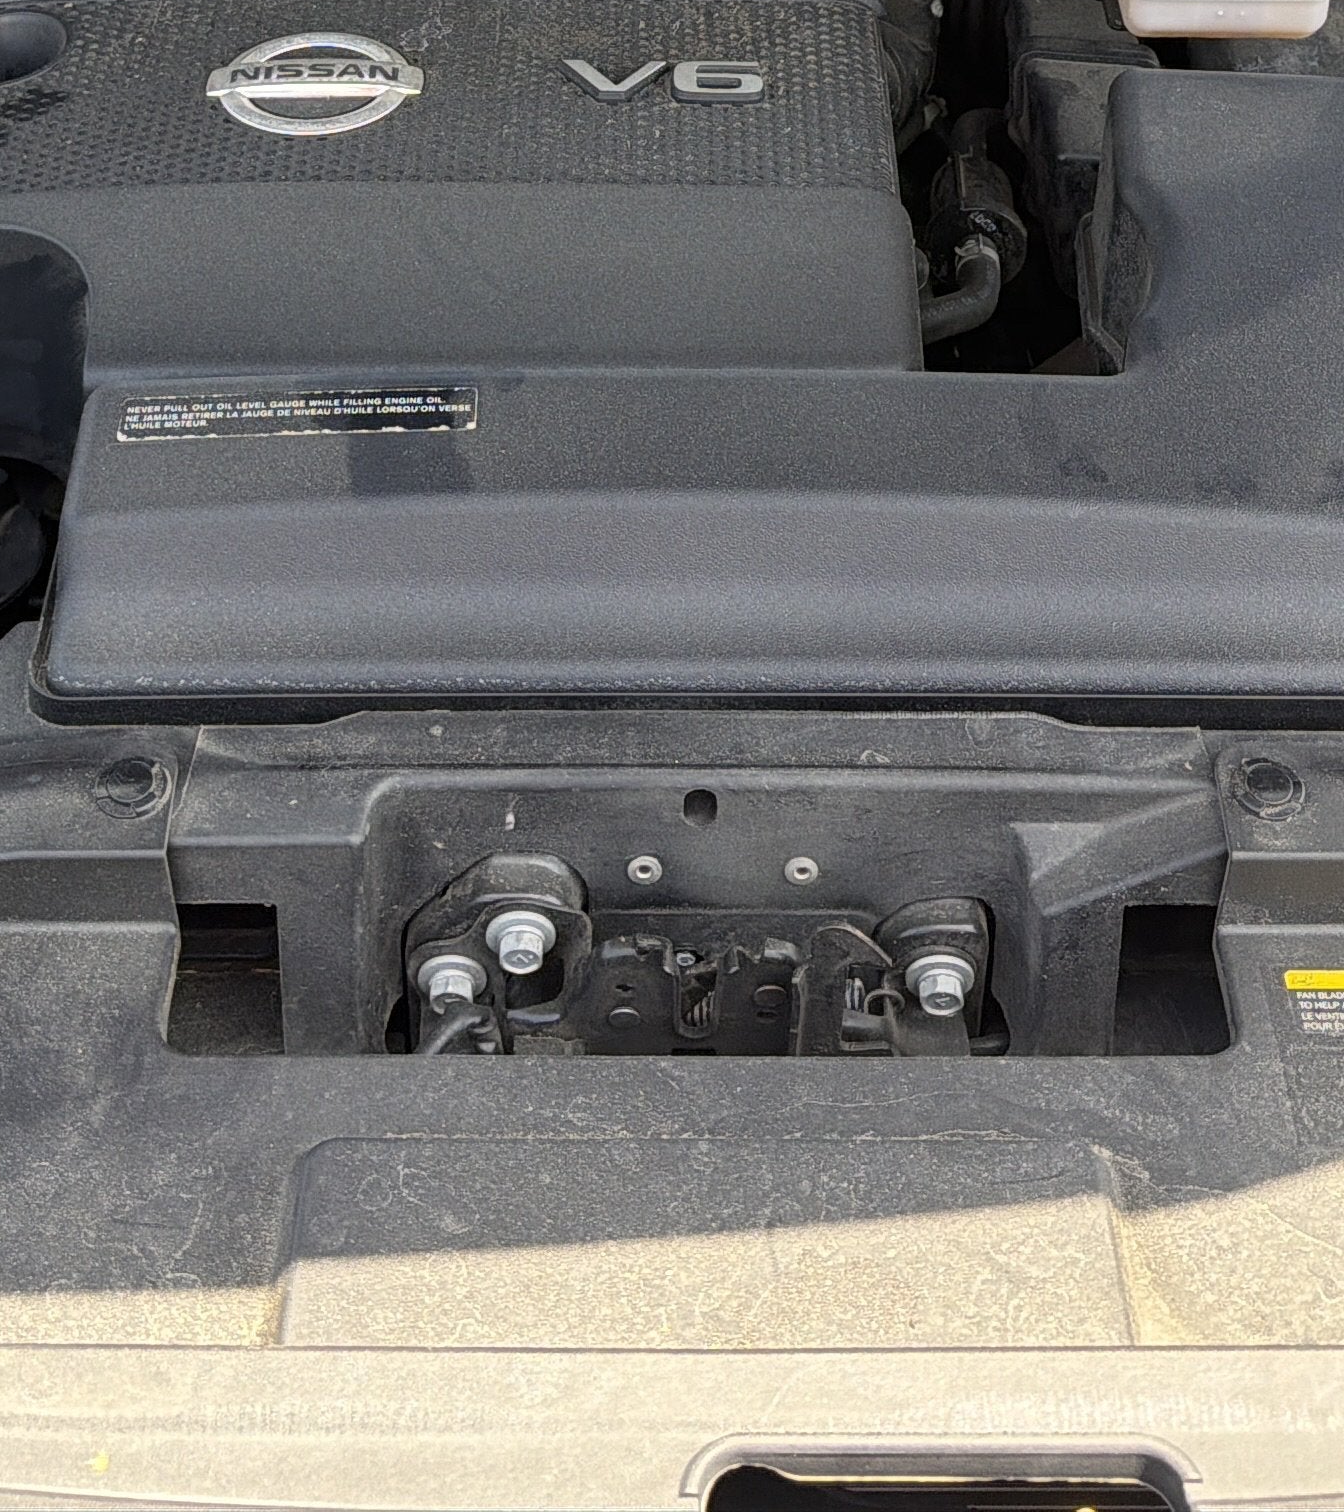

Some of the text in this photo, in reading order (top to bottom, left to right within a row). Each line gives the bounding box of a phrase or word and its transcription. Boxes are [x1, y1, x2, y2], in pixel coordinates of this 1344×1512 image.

[230, 63, 399, 83] NISSAN
[561, 60, 766, 104] V6
[127, 396, 446, 414] NEVER PULL OUT OIL LEVEL GAUGE WHILE FILLING ENGINE OIL.
[142, 413, 179, 422] JAMAIS
[181, 412, 224, 420] RETIRER
[226, 410, 239, 418] LA
[241, 409, 274, 418] JAUGE
[276, 408, 291, 416] DE
[294, 407, 331, 416] NIVEAU
[334, 406, 374, 414] D'HUILE
[376, 404, 436, 414] LORSQU'ON
[439, 404, 472, 412] VERSE
[124, 419, 209, 430] L'HUILE MOTEUR.
[1299, 1001, 1312, 1010] TO
[1314, 1001, 1340, 1010] HELP
[1302, 1012, 1314, 1020] LE
[1304, 1022, 1334, 1030] POUR
